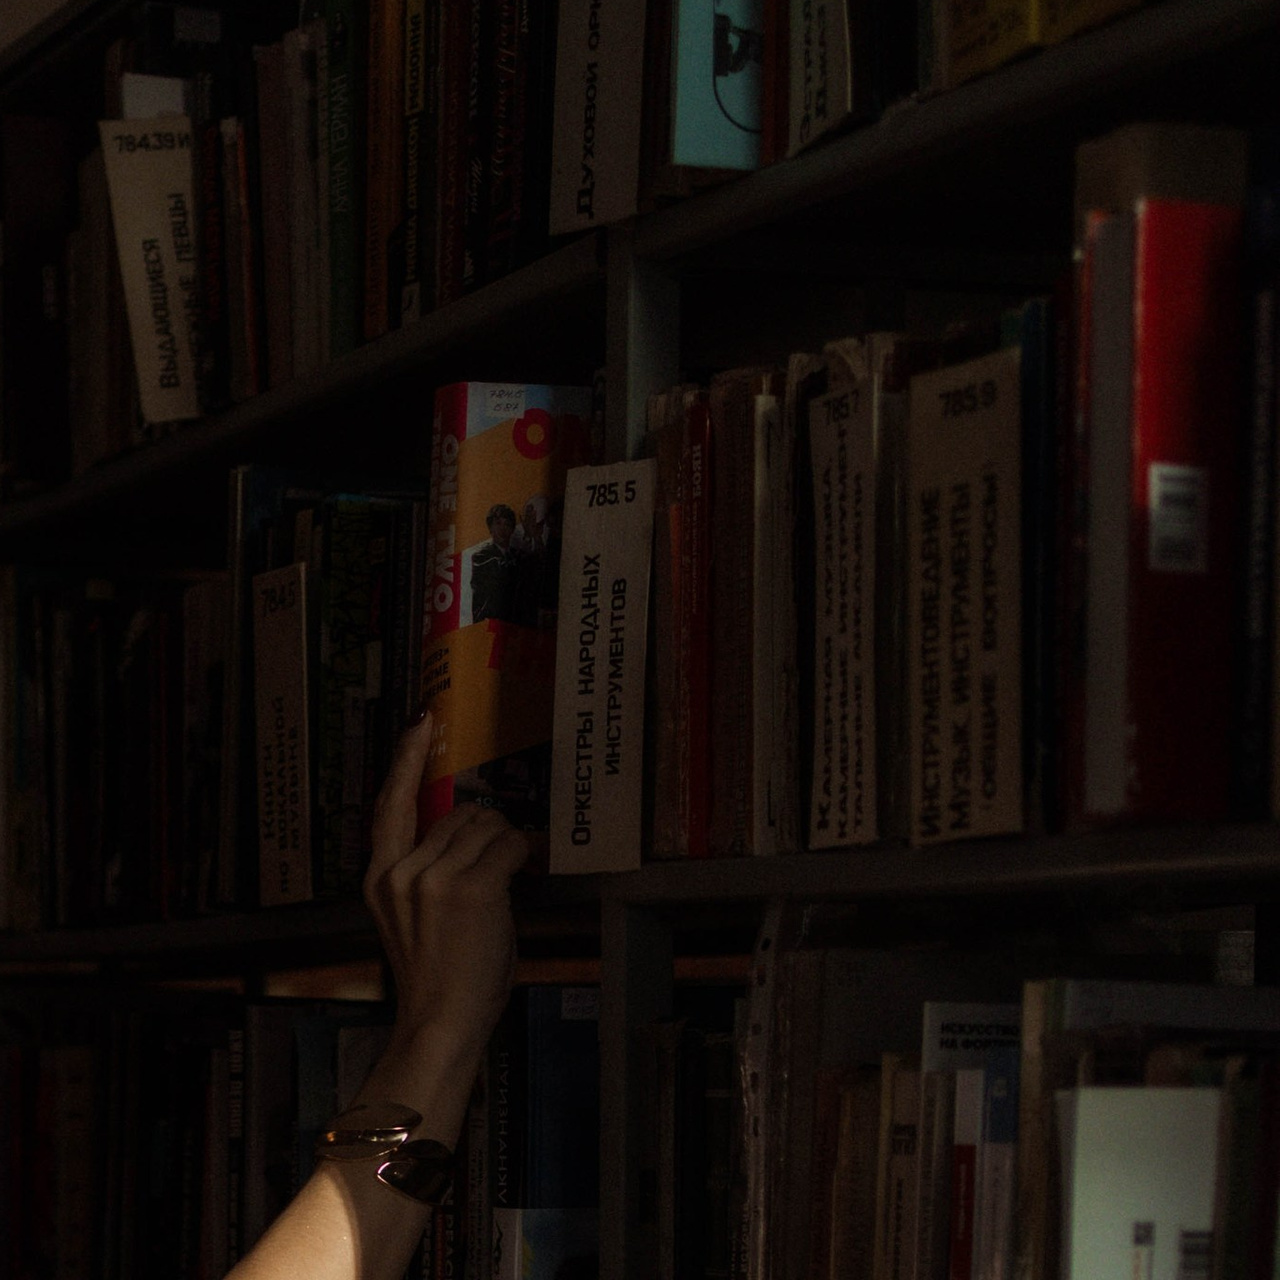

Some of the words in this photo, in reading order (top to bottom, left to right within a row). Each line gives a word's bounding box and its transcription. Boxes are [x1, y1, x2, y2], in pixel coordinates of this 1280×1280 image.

[330, 73, 349, 155] ГЕРМАН
[576, 61, 598, 220] ДУХОВОЙ
[166, 191, 195, 263] ПЕВЦЫ
[141, 238, 181, 389] ВЫДАЮЩИЕСЯ
[437, 433, 460, 512] ONE
[432, 523, 456, 613] TWO
[577, 552, 602, 696] НАРОДНЫХ
[948, 483, 971, 704] ИНСТРУМЕНТЫ
[981, 474, 998, 652] ВОПРОСЫ
[604, 577, 627, 776] ИНСТРУМЕНТОВ
[919, 486, 942, 836] ИНСТРУМЕНТОВЕДЕНИЕ
[570, 711, 595, 846] ОРКЕСТРЫ
